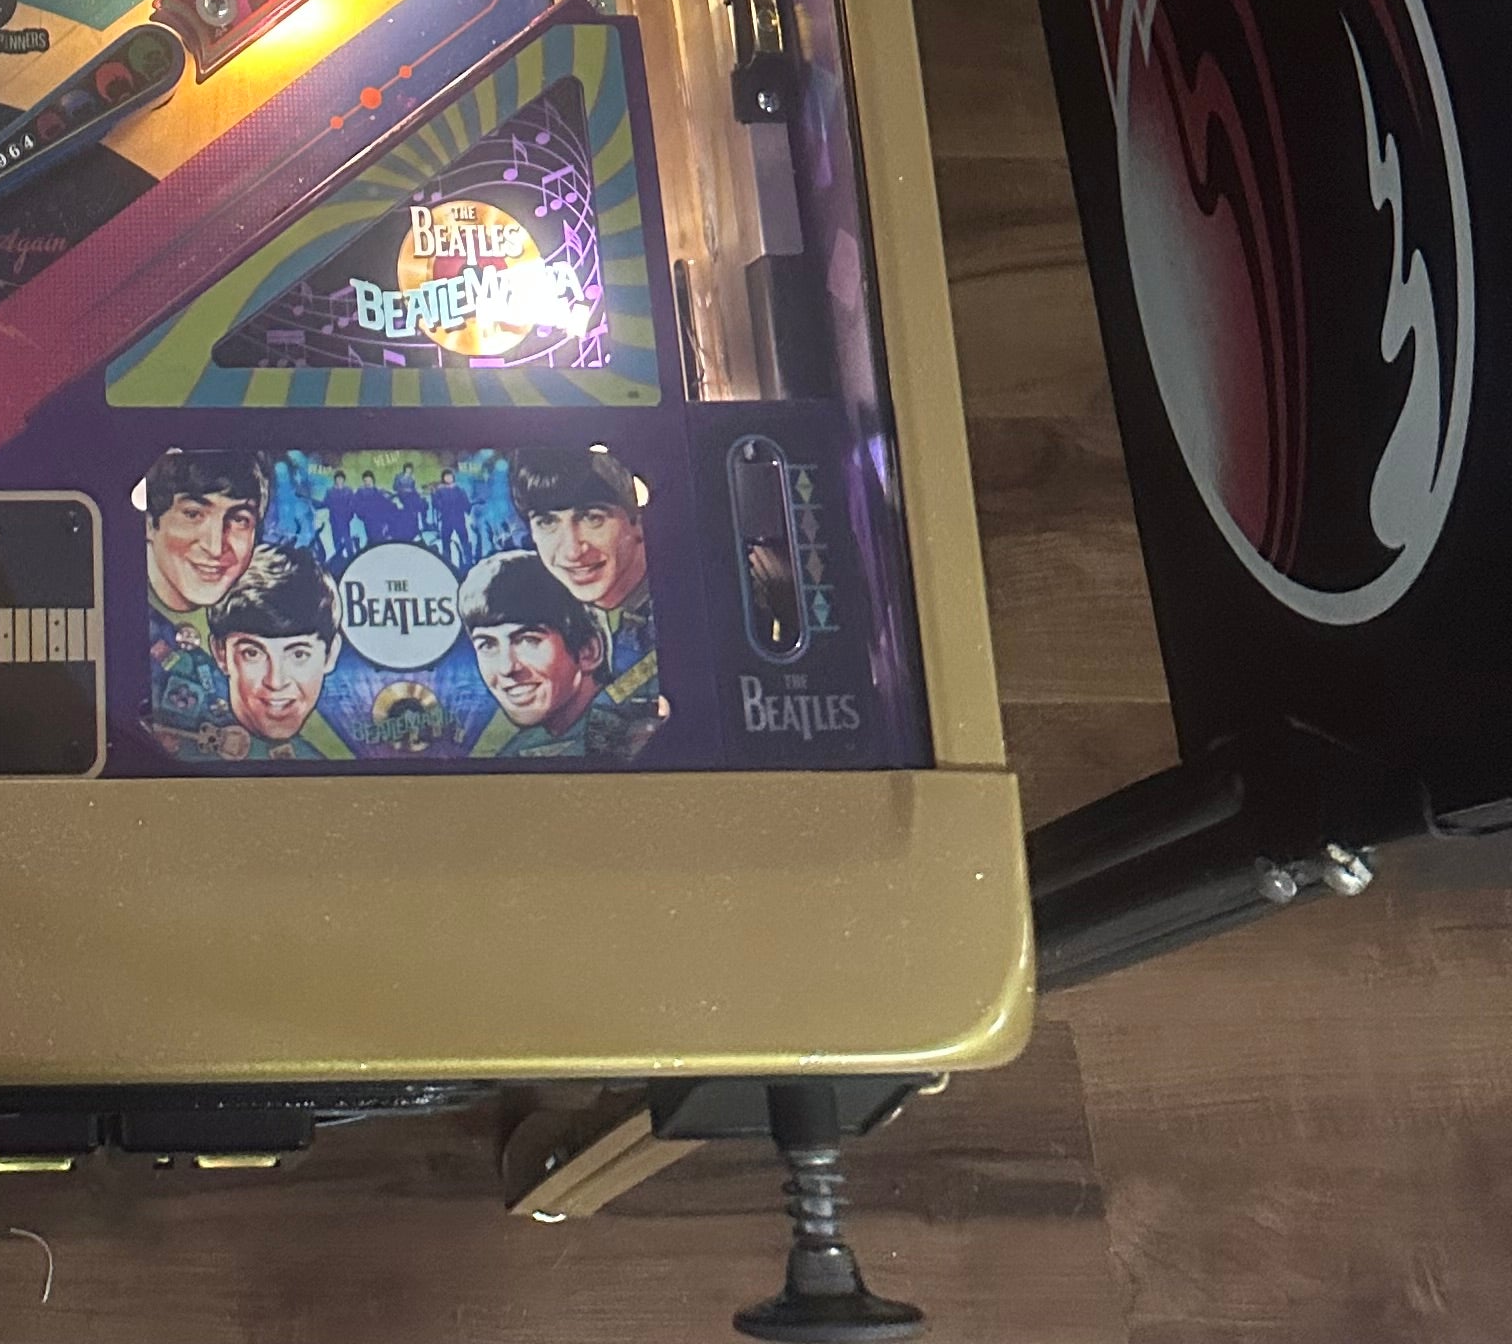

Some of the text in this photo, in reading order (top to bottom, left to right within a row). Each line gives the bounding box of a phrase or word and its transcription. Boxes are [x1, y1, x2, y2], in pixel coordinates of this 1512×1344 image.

[410, 206, 524, 265] BEATLES
[452, 207, 475, 220] THE
[345, 581, 455, 635] BEATLES
[385, 580, 409, 594] THE
[740, 675, 860, 741] BEATLES
